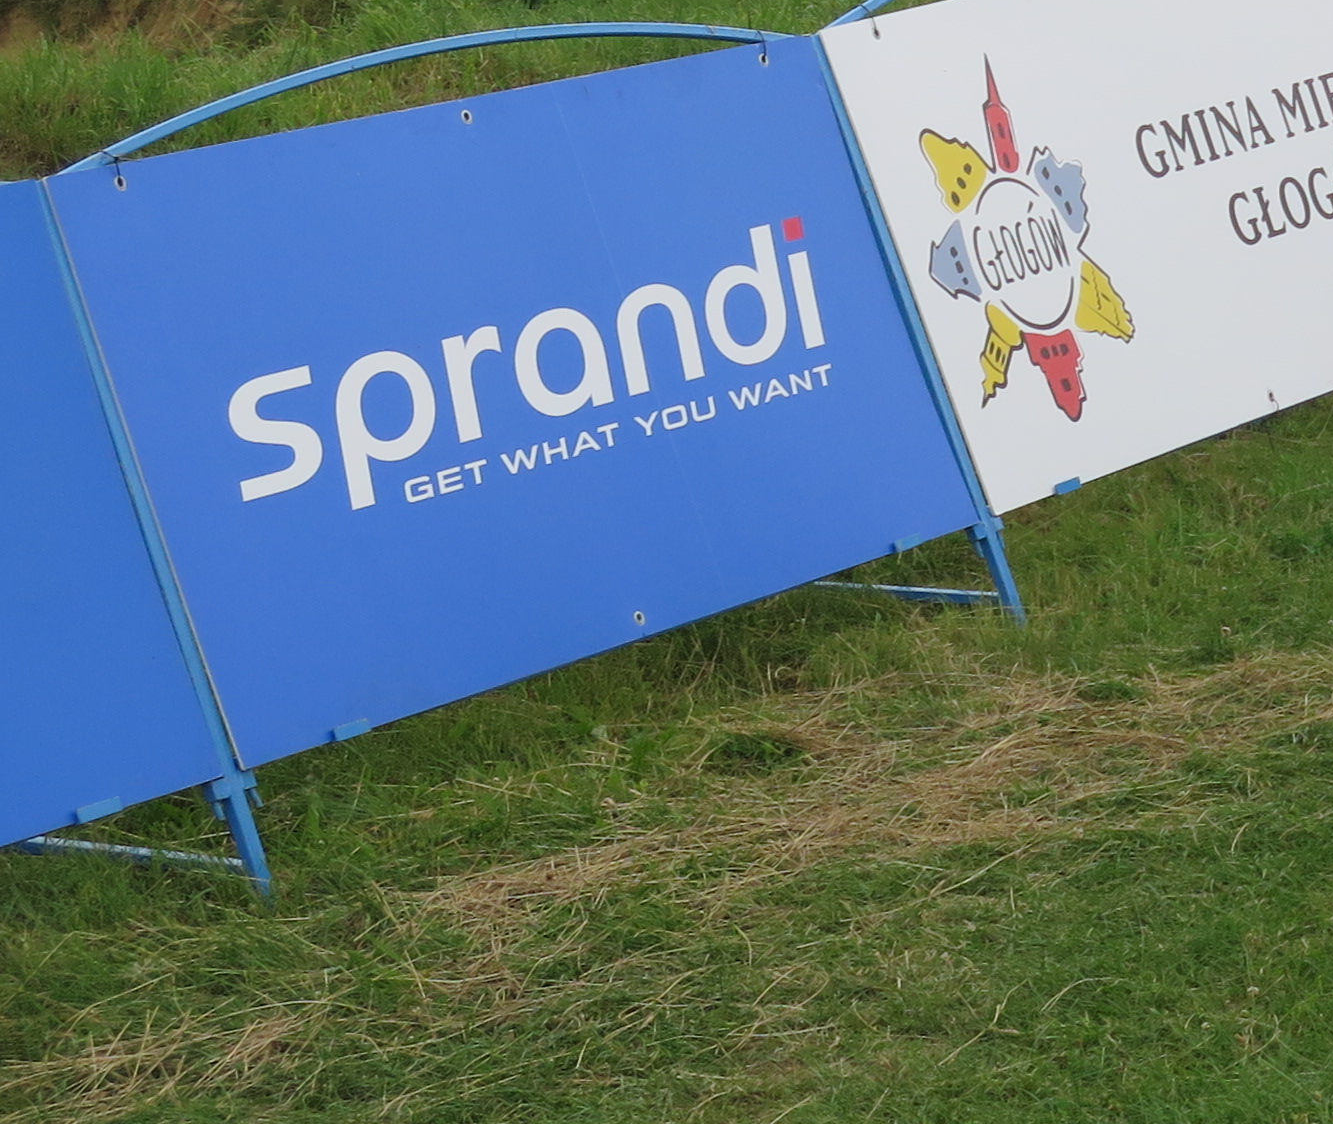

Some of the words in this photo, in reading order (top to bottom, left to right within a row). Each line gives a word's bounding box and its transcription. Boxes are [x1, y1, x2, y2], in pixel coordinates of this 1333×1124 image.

[1135, 95, 1275, 178] GMINA
[973, 201, 1071, 291] GŁOGÓW
[227, 215, 827, 510] sprandi
[403, 459, 489, 505] GET
[500, 422, 620, 476] WHAT
[633, 395, 718, 438] YOU
[728, 363, 834, 412] WANT
